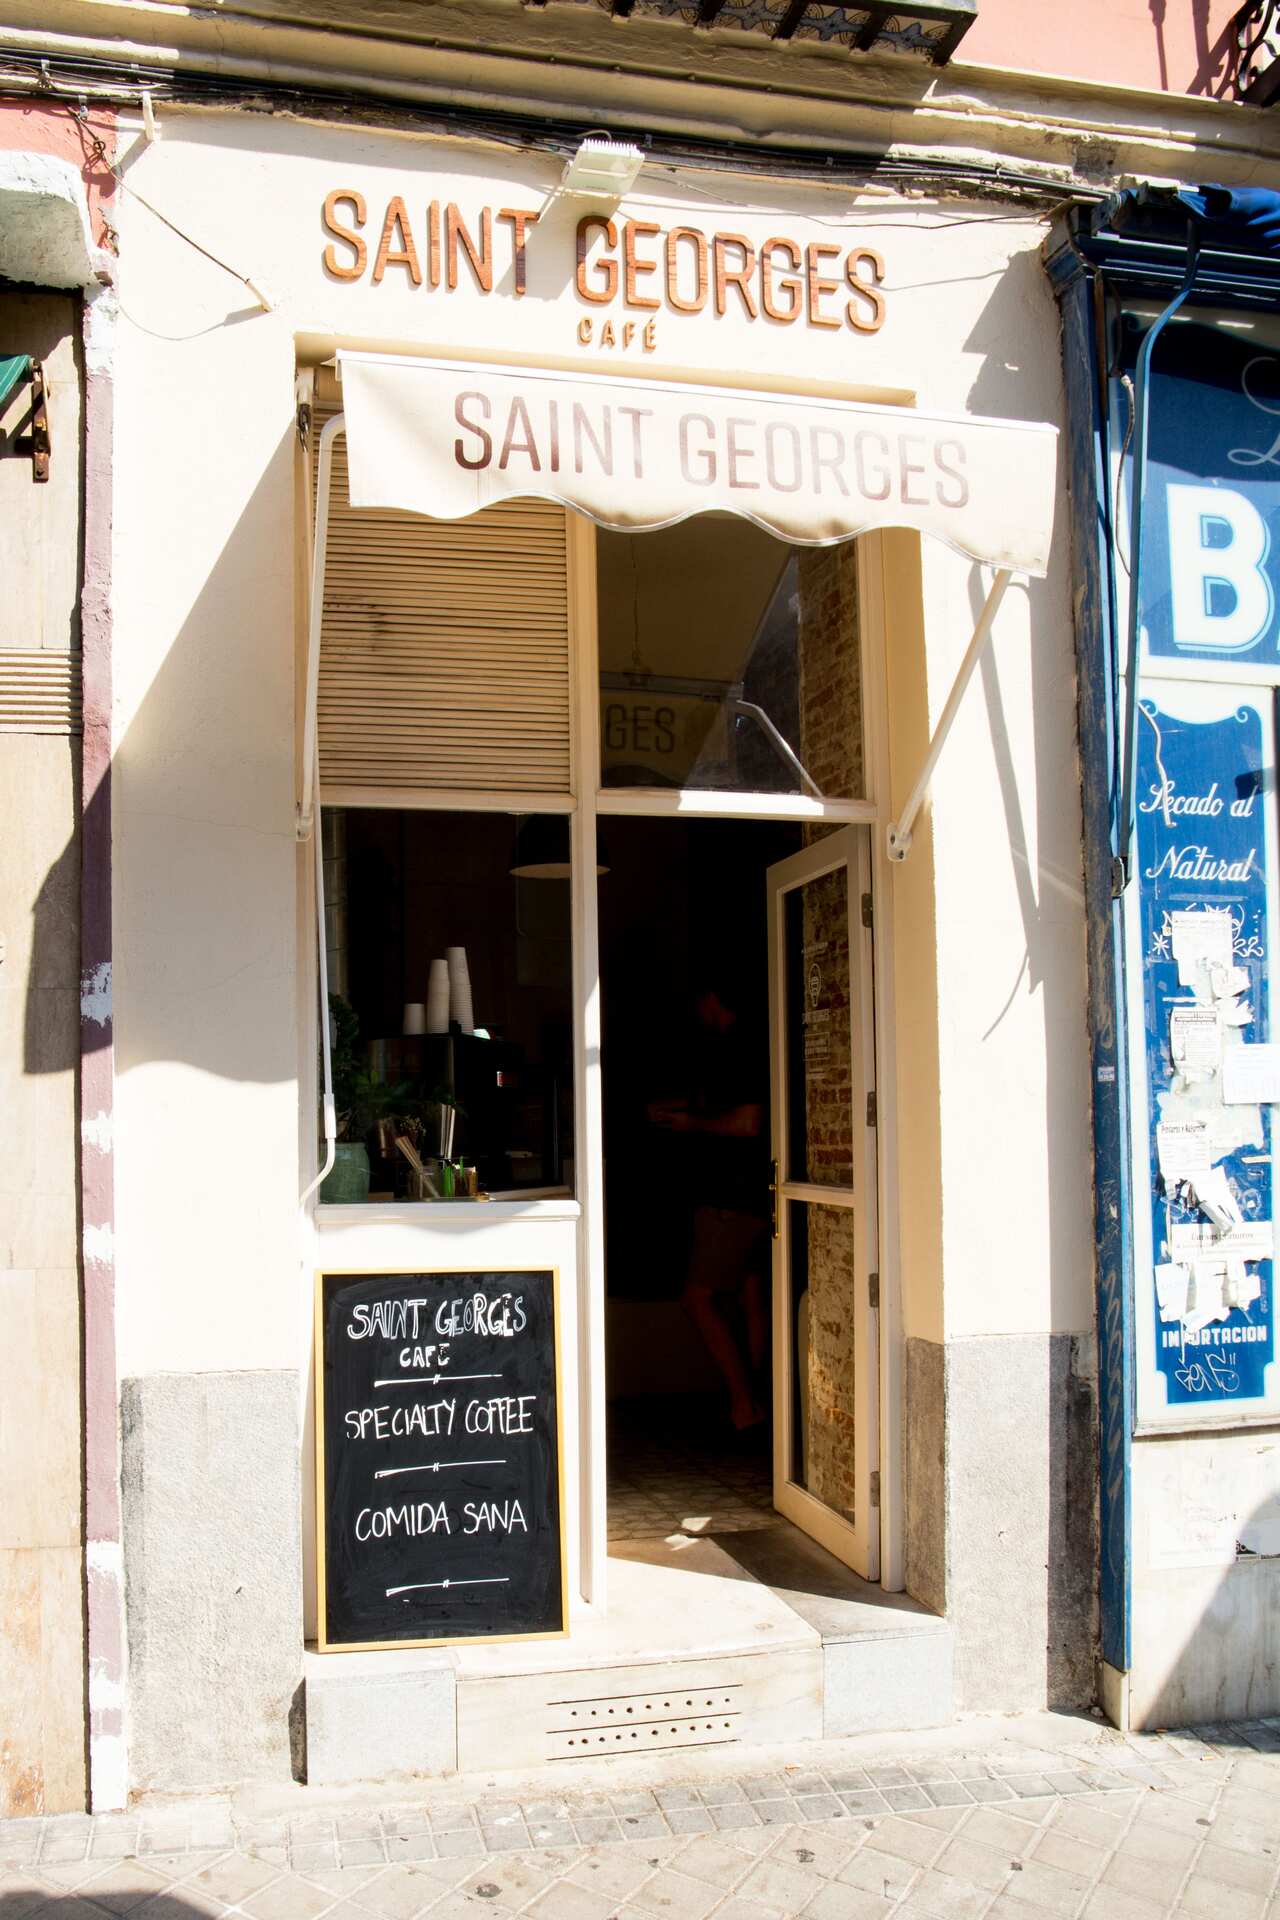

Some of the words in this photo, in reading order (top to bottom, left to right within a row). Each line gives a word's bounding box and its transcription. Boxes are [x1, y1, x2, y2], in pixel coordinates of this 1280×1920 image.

[321, 188, 540, 296] SAINT
[575, 214, 887, 334] GEORGES
[577, 316, 658, 352] CAFÉ
[453, 390, 654, 480] SAINT
[678, 411, 970, 509] GEORGES
[1139, 780, 1224, 816] Secado
[1230, 784, 1259, 817] al
[1146, 845, 1257, 882] Natural
[347, 1298, 427, 1340] SAINT
[435, 1292, 527, 1338] GEORGES
[345, 1398, 457, 1440] SPECIALTY
[465, 1395, 537, 1435] COFFEE
[355, 1501, 450, 1542] COMIDA
[463, 1500, 528, 1535] SANA
